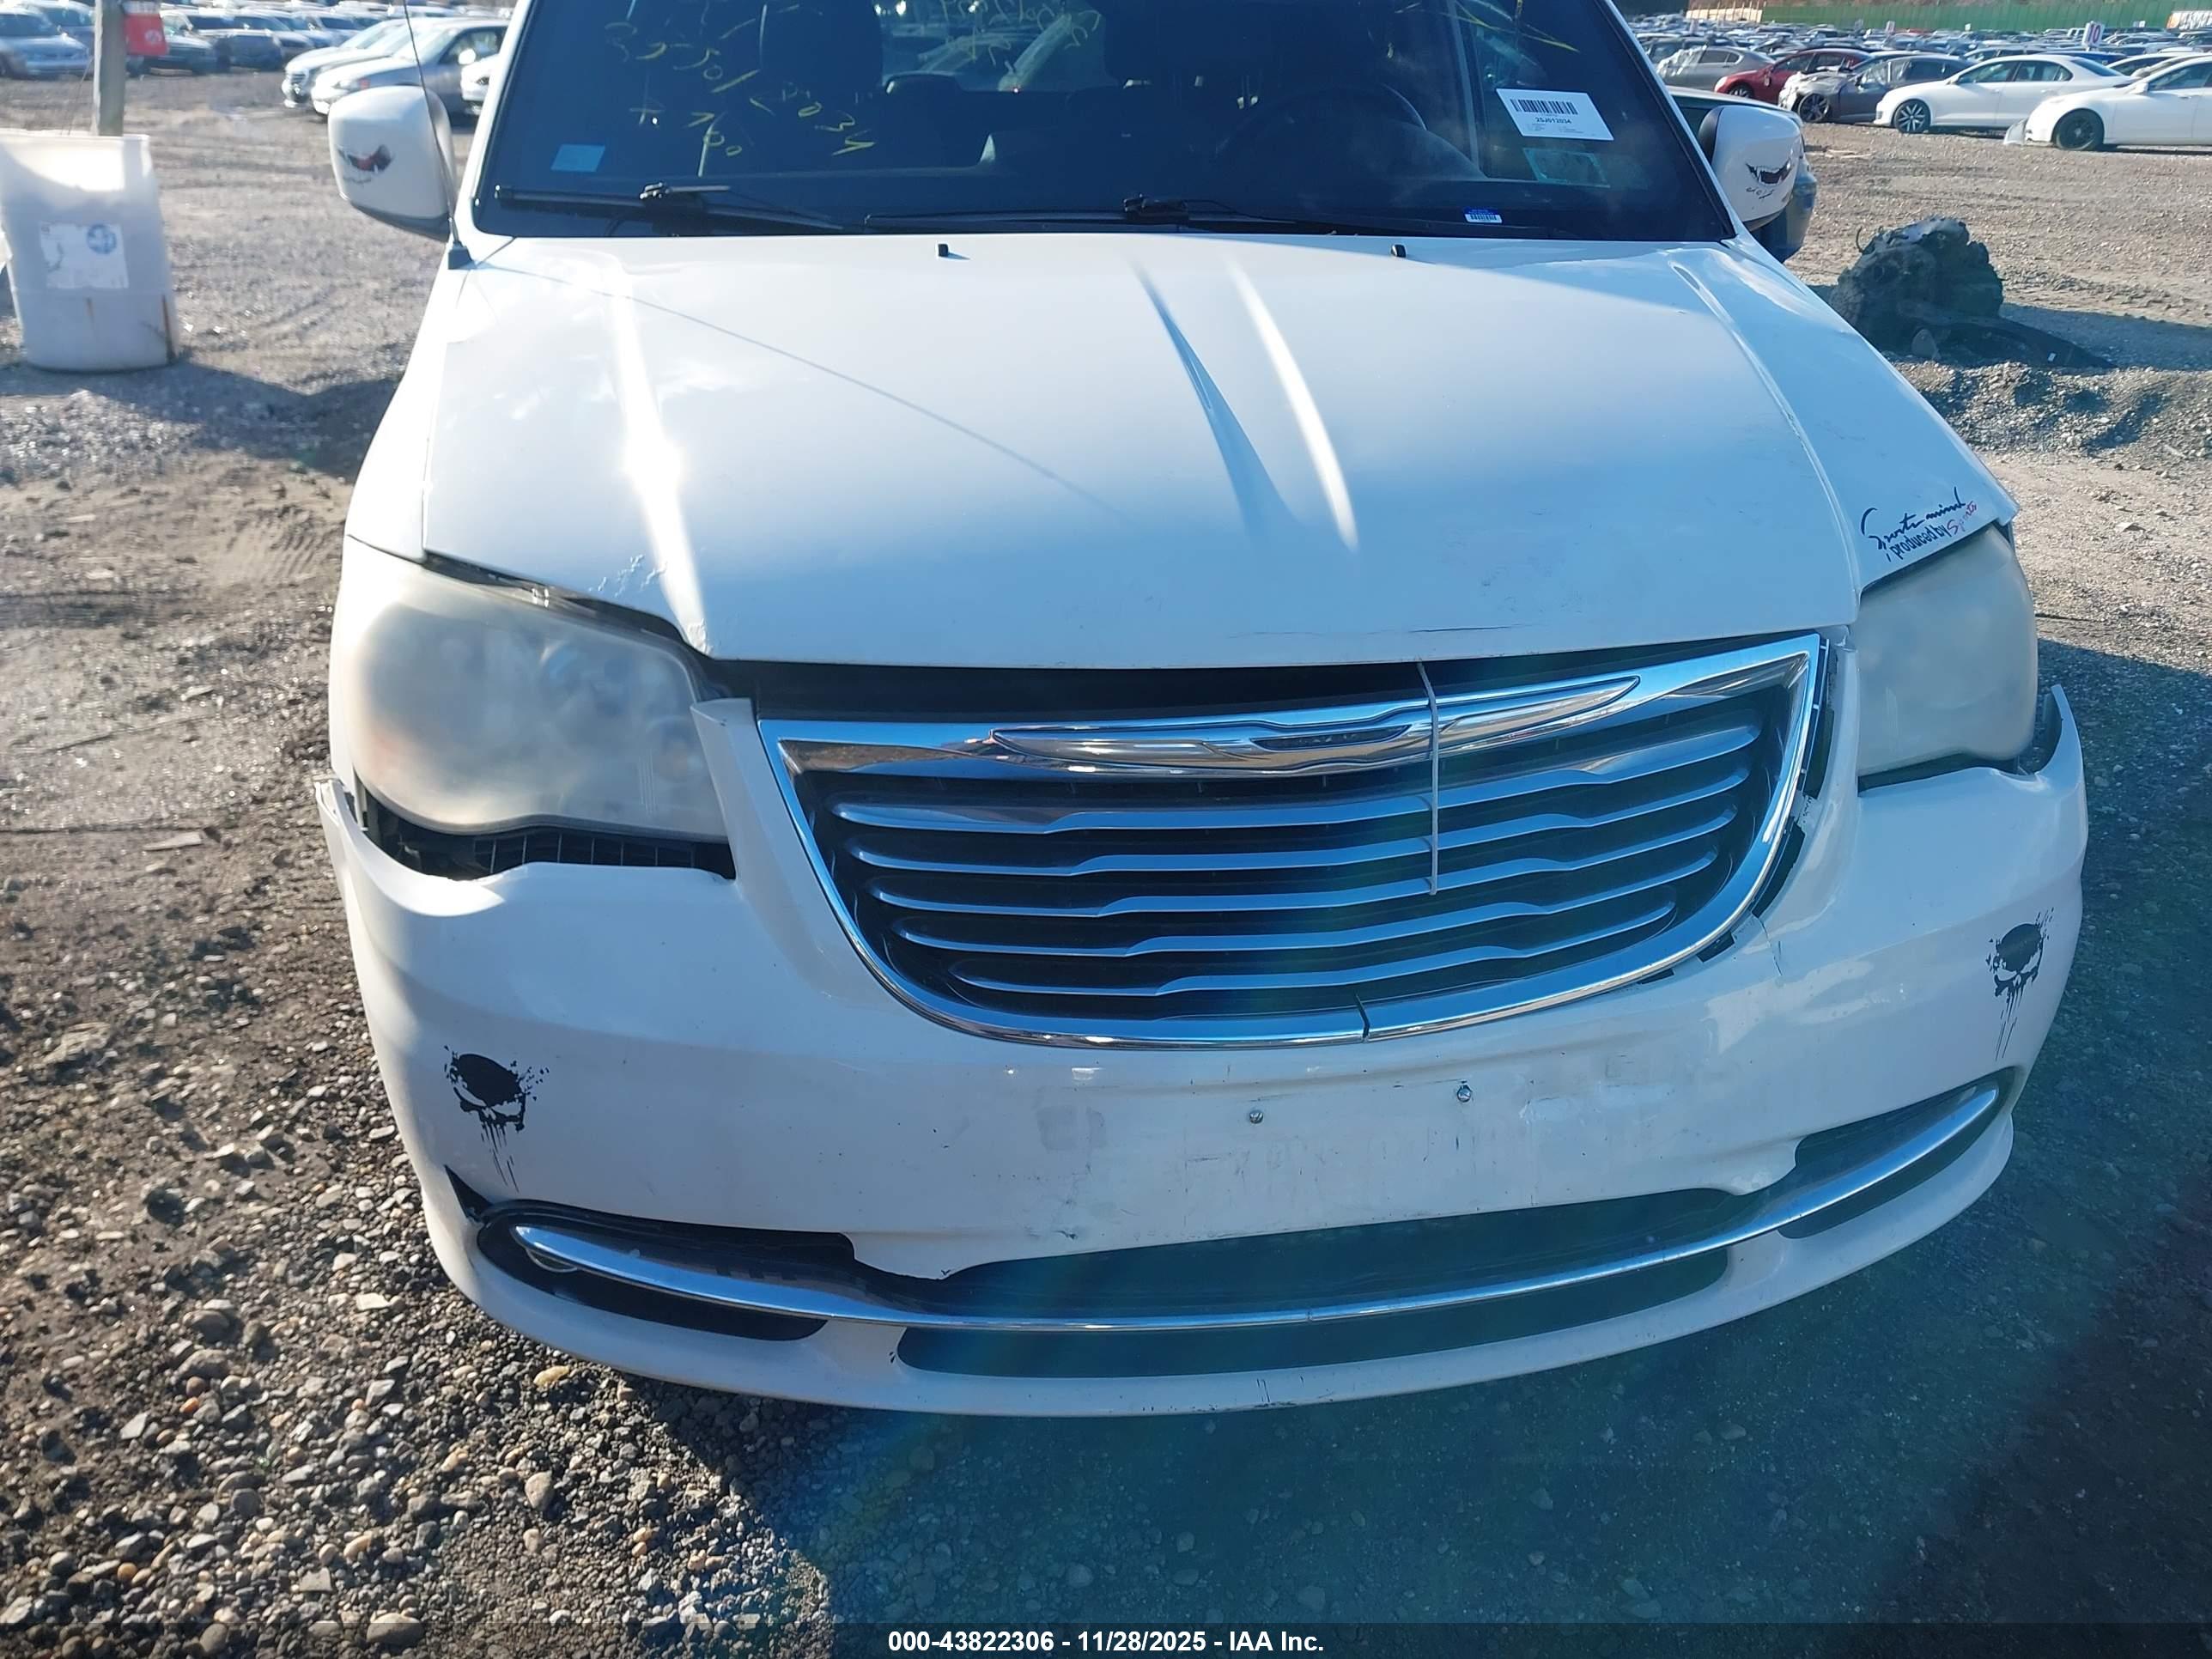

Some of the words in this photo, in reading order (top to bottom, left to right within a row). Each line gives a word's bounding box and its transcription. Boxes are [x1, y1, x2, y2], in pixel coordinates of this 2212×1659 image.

[2087, 24, 2100, 43] 10
[1889, 526, 1937, 560] produced
[1929, 525, 1952, 538] by
